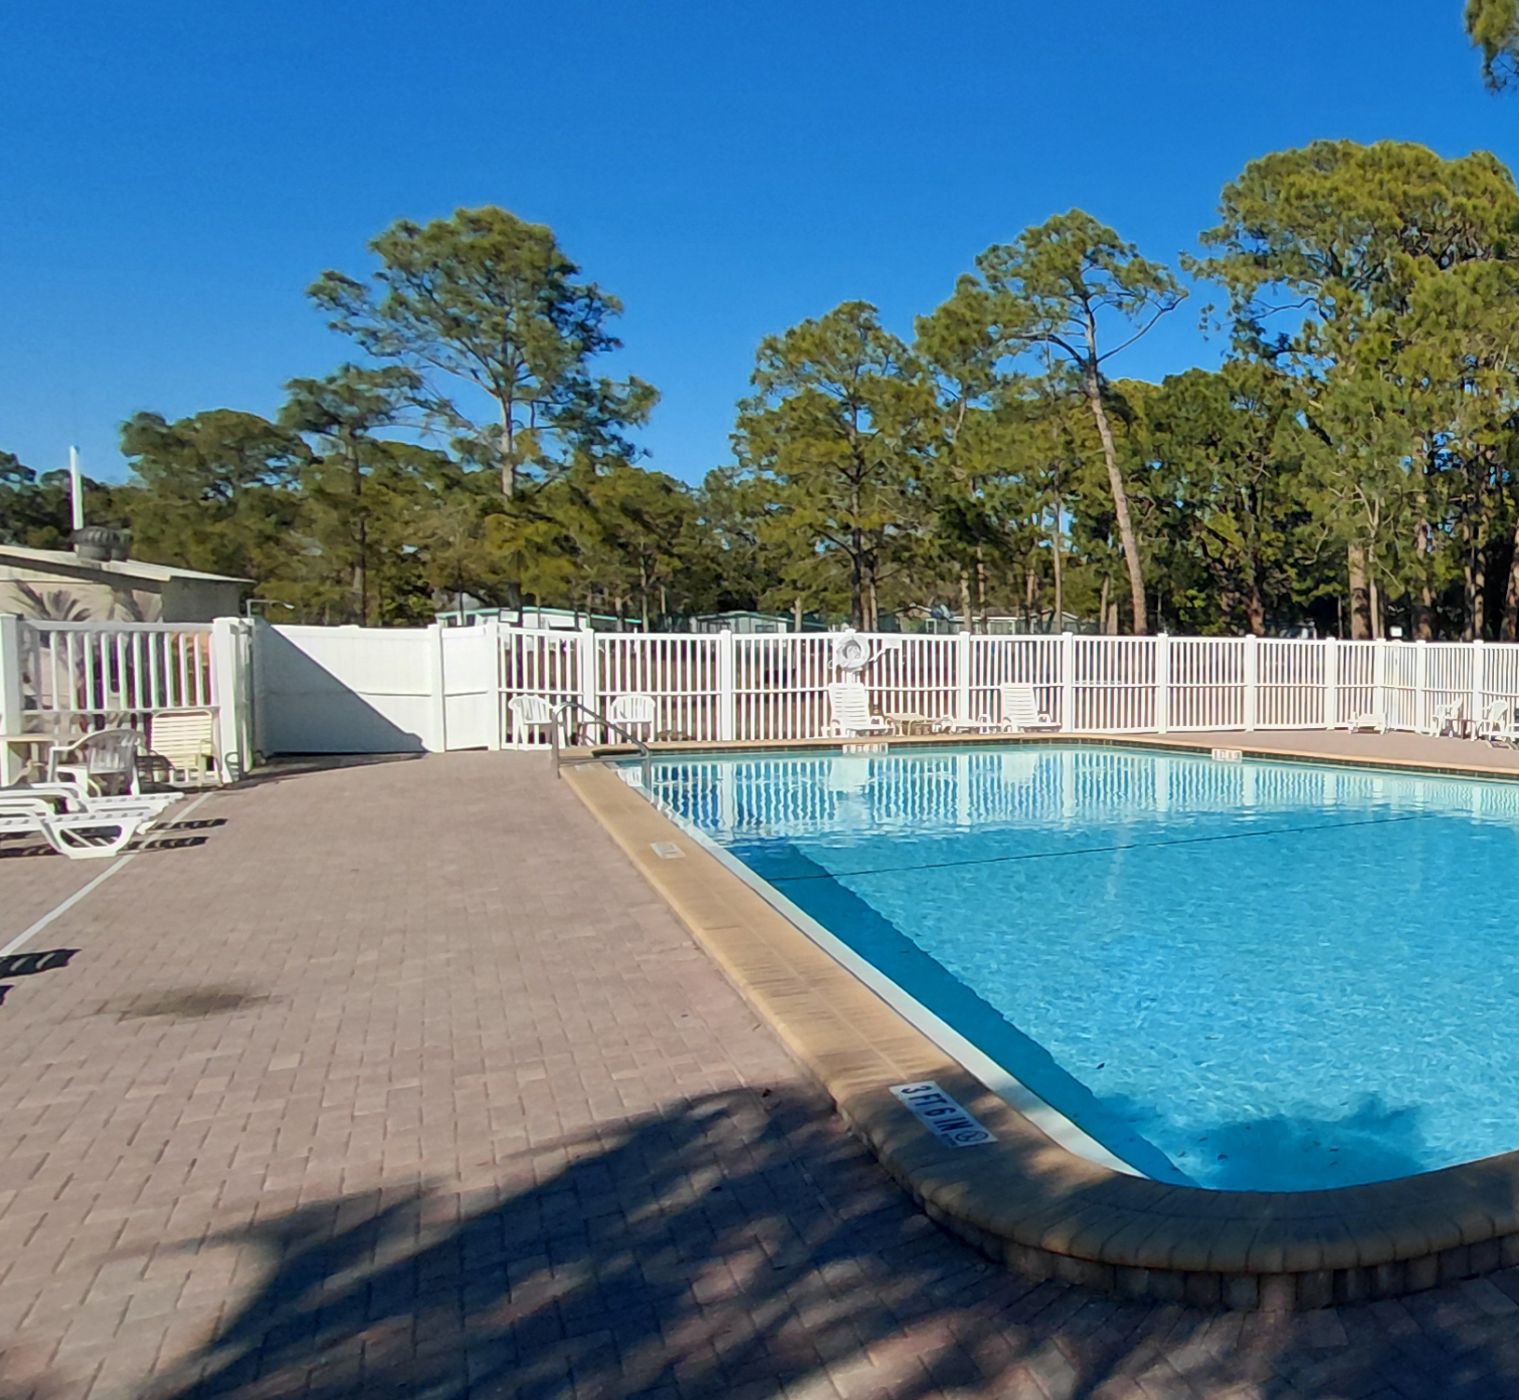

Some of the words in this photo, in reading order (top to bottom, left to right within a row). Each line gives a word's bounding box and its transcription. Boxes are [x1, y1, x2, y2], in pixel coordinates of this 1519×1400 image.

[901, 1085, 933, 1095] 3
[908, 1092, 948, 1107] FT
[924, 1106, 957, 1117] 6
[933, 1116, 974, 1133] IN
